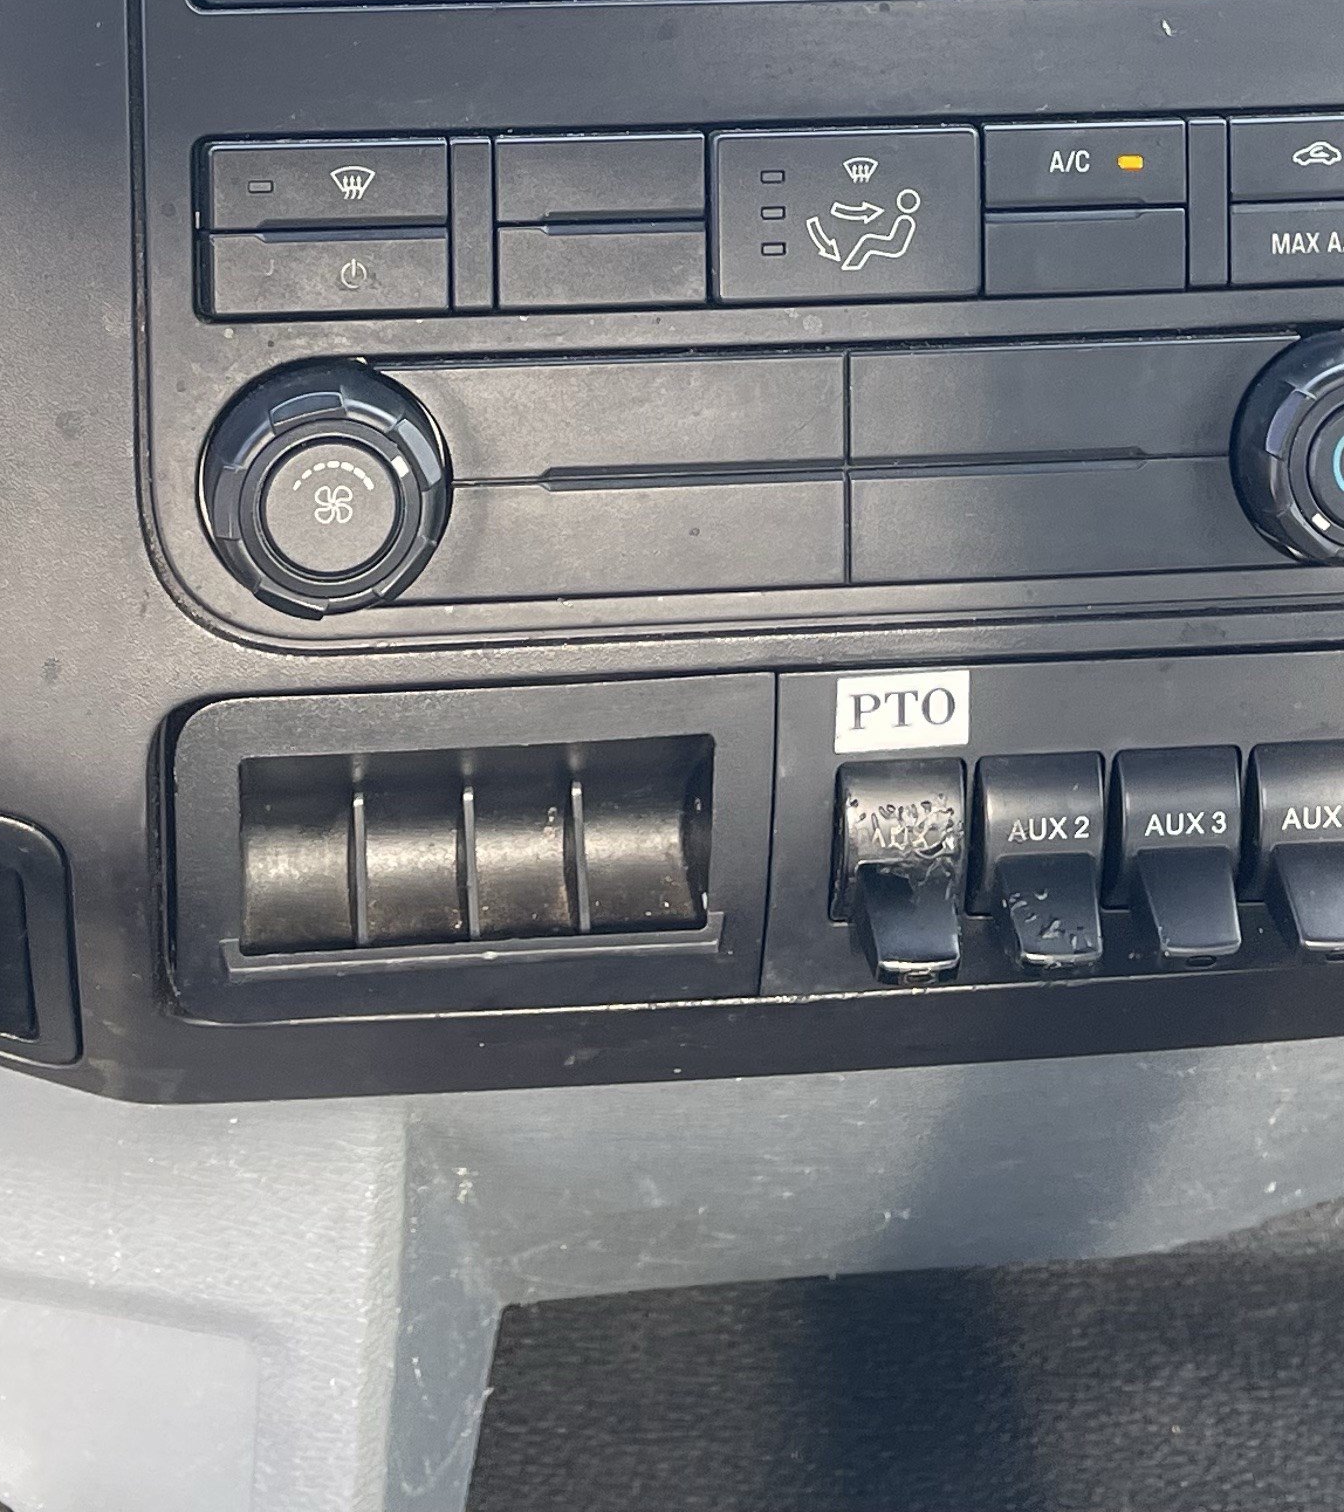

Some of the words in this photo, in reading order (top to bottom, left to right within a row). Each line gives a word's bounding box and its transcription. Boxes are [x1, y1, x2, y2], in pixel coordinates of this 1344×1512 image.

[1049, 152, 1091, 175] A/C
[1270, 232, 1321, 255] MAX
[849, 687, 955, 731] PTO
[1008, 819, 1066, 842] AUX
[1075, 816, 1090, 839] 2
[1144, 814, 1205, 837] AUX
[1211, 812, 1227, 834] 3
[1281, 807, 1340, 831] AUX
